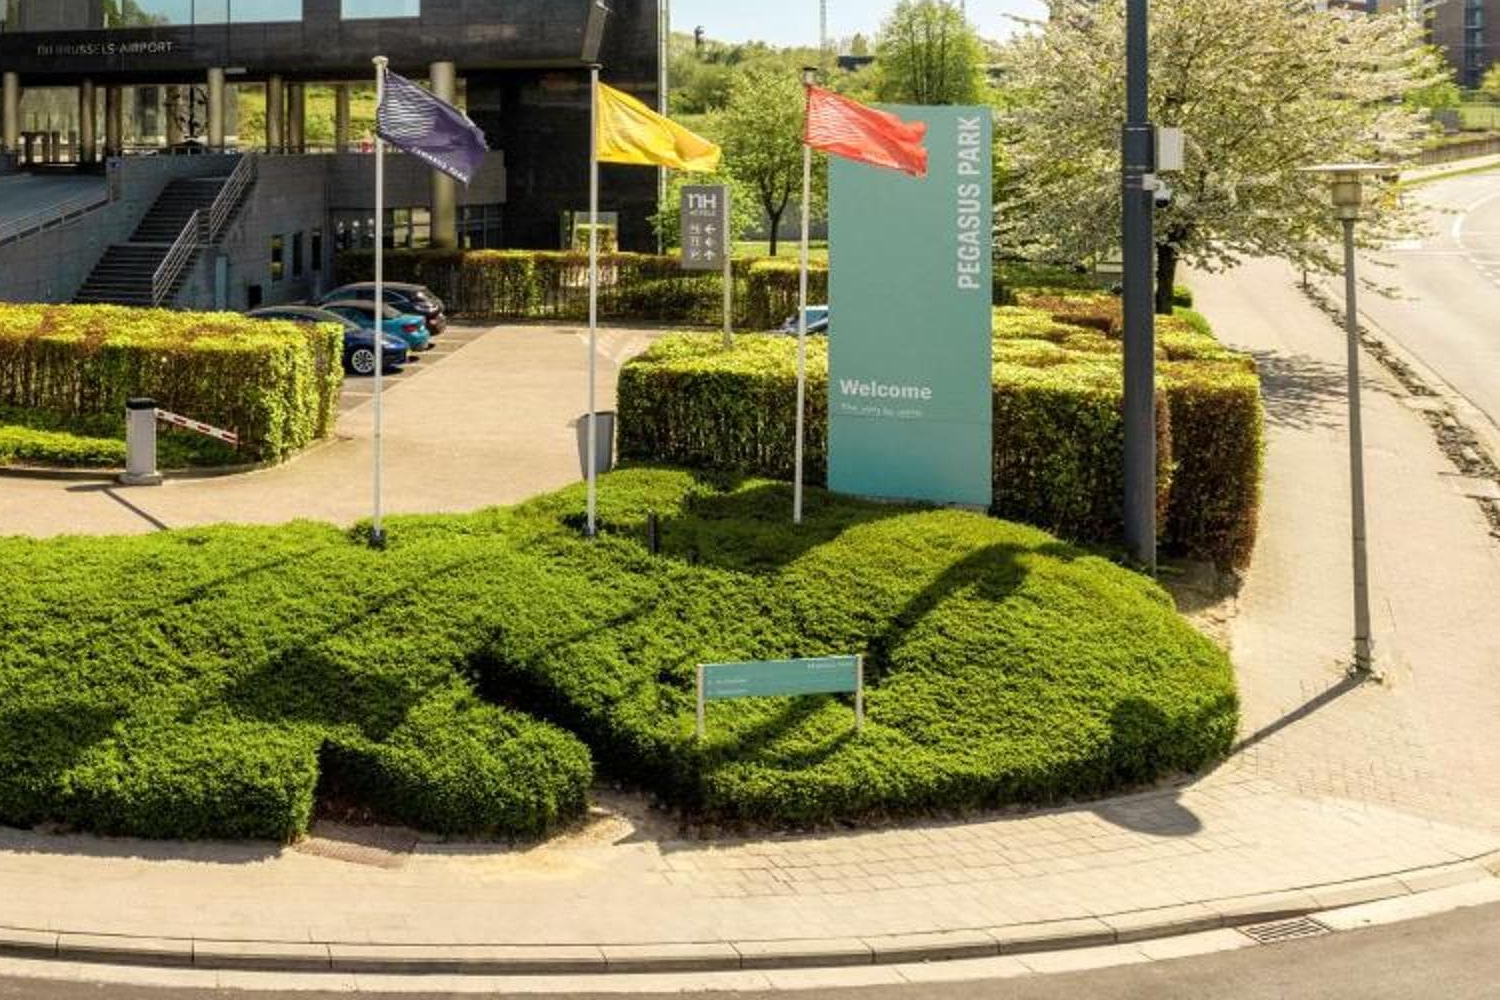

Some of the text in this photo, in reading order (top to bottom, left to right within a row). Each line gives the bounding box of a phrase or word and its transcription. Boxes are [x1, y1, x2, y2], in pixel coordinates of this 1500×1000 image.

[119, 41, 173, 54] AIRPORT
[957, 115, 982, 290] PEGASUS PARK
[839, 379, 933, 400] Welcome
